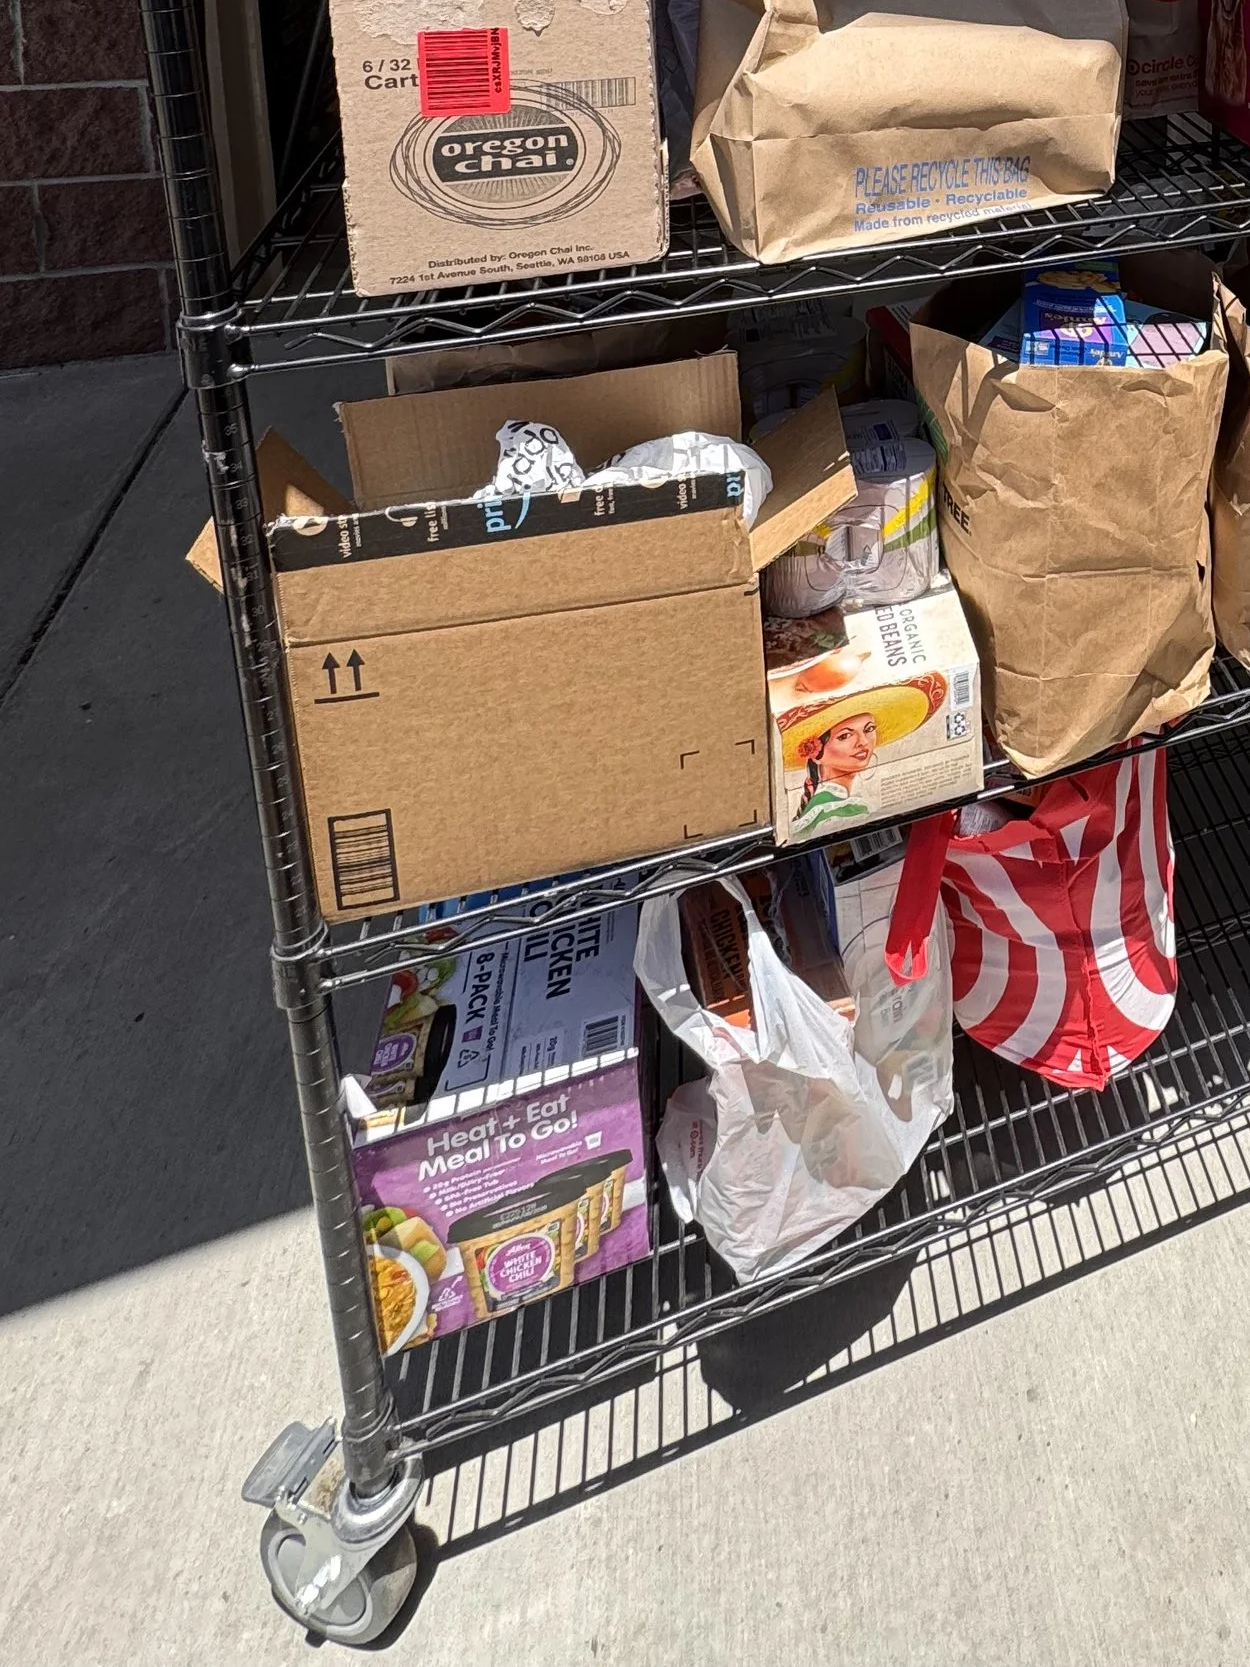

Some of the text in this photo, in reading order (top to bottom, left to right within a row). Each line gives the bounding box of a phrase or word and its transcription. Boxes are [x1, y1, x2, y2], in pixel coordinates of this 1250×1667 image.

[362, 58, 412, 73] 6 32
[1141, 56, 1185, 74] circle
[441, 134, 569, 156] oregon
[454, 150, 558, 174] chai
[855, 155, 1031, 198] PLEASE RECYCLE THIS BAG
[856, 187, 1028, 215] Reusable Recyclable
[854, 207, 980, 233] Made from recycled
[389, 250, 630, 285] 7224 1st Avenue South, Seattle, WA USA
[428, 243, 595, 269] Distributed Oregon Chai Inc.
[594, 496, 606, 517] free
[676, 482, 689, 510] video
[338, 530, 352, 558] video
[426, 520, 440, 543] free
[879, 622, 908, 667] BEANS
[899, 608, 927, 664] ORGANIC
[465, 951, 496, 1024] 8-PACK
[427, 1094, 571, 1158] Heat + Eat
[418, 1110, 579, 1182] Meal To Go!
[498, 1254, 543, 1277] CHICKEN
[503, 1250, 537, 1270] WHITE
[508, 1265, 536, 1281] CHILI
